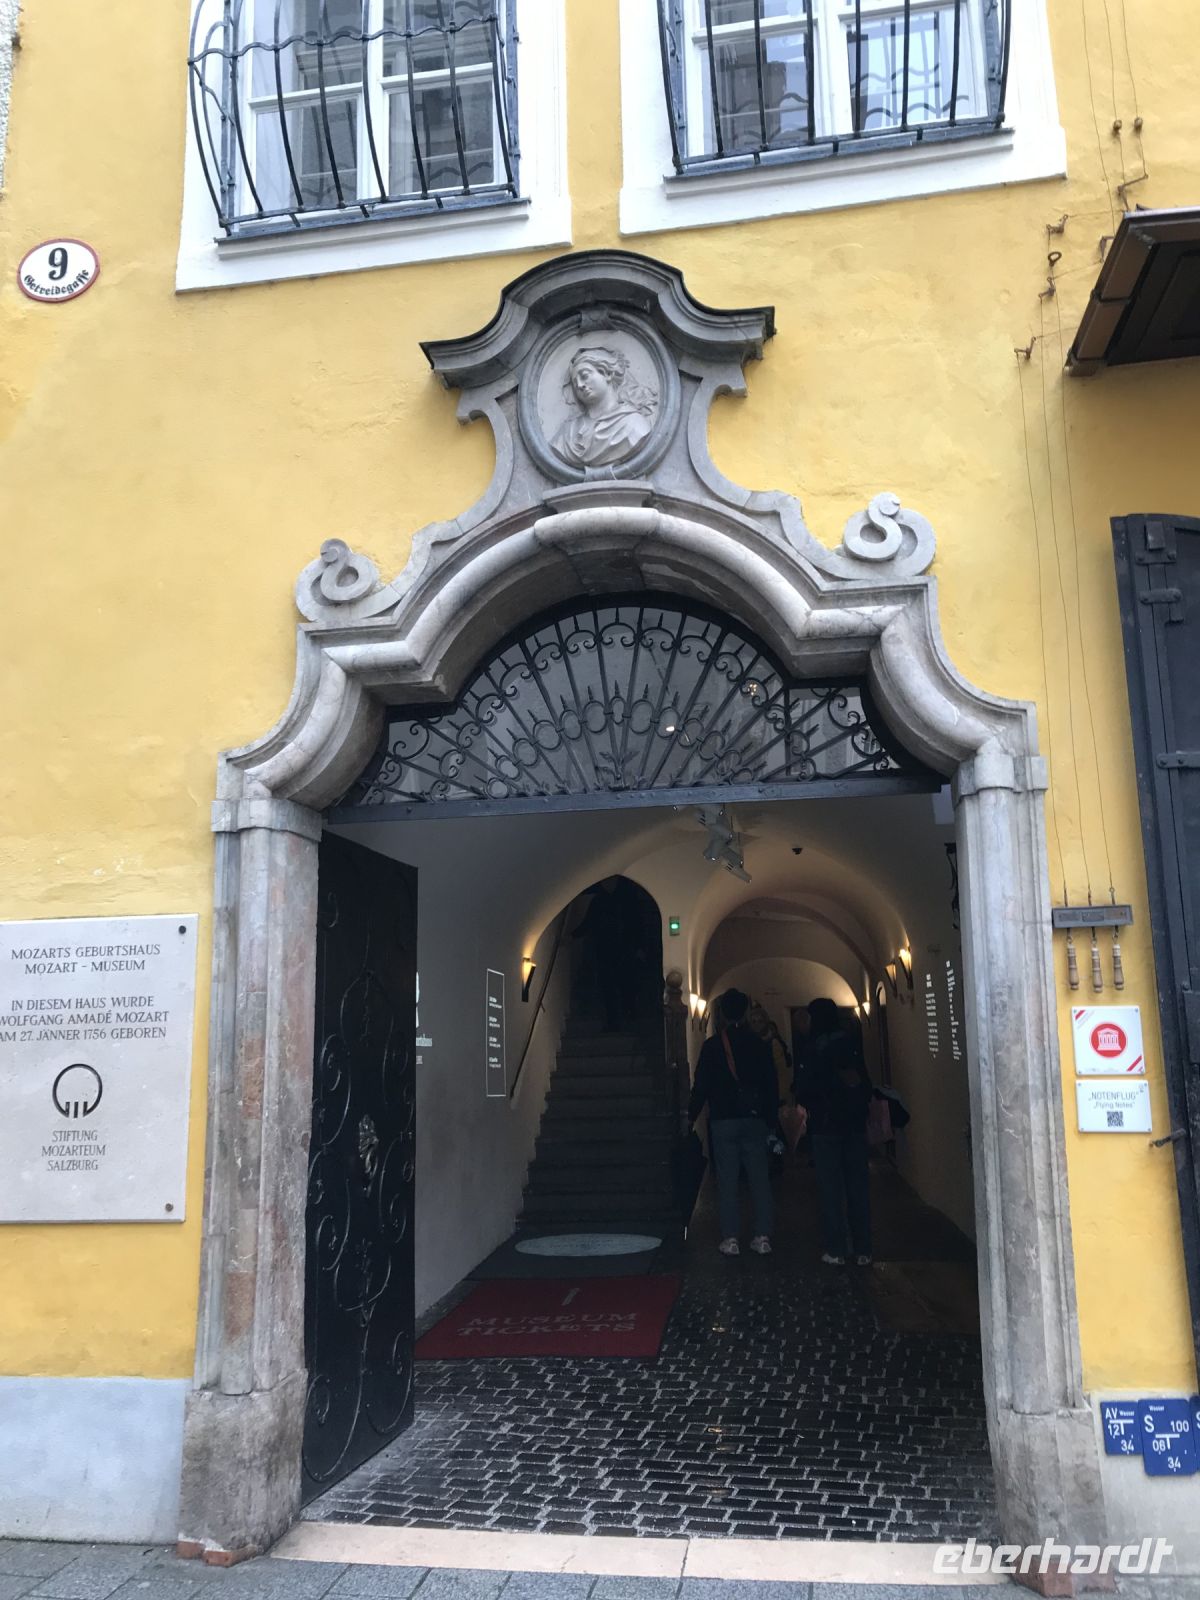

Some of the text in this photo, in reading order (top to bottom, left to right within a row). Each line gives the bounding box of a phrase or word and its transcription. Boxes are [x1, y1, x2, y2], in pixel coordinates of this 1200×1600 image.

[48, 247, 68, 281] 9
[11, 944, 161, 960] MOZARTS GEBURTSHAUS
[25, 962, 78, 975] MOZART
[90, 960, 146, 972] MUSEUM
[11, 996, 155, 1011] IN DIESEM HAUS WURDE
[67, 1010, 113, 1025] AMADÉ
[115, 1011, 169, 1023] MOZART
[20, 1031, 34, 1041] 27.
[36, 1028, 80, 1041] JÄNNER
[83, 1028, 107, 1040] 1756
[110, 1027, 167, 1039] GEBOREN
[52, 1130, 98, 1142] STIFTUNG
[41, 1145, 106, 1157] MOZARTEUM
[46, 1159, 99, 1171] SALZBURG
[467, 1312, 638, 1326] MUSEUM
[456, 1323, 635, 1337] TICKETS
[1105, 1407, 1118, 1419] AV
[1144, 1414, 1155, 1433] S
[1170, 1420, 1189, 1432] 100
